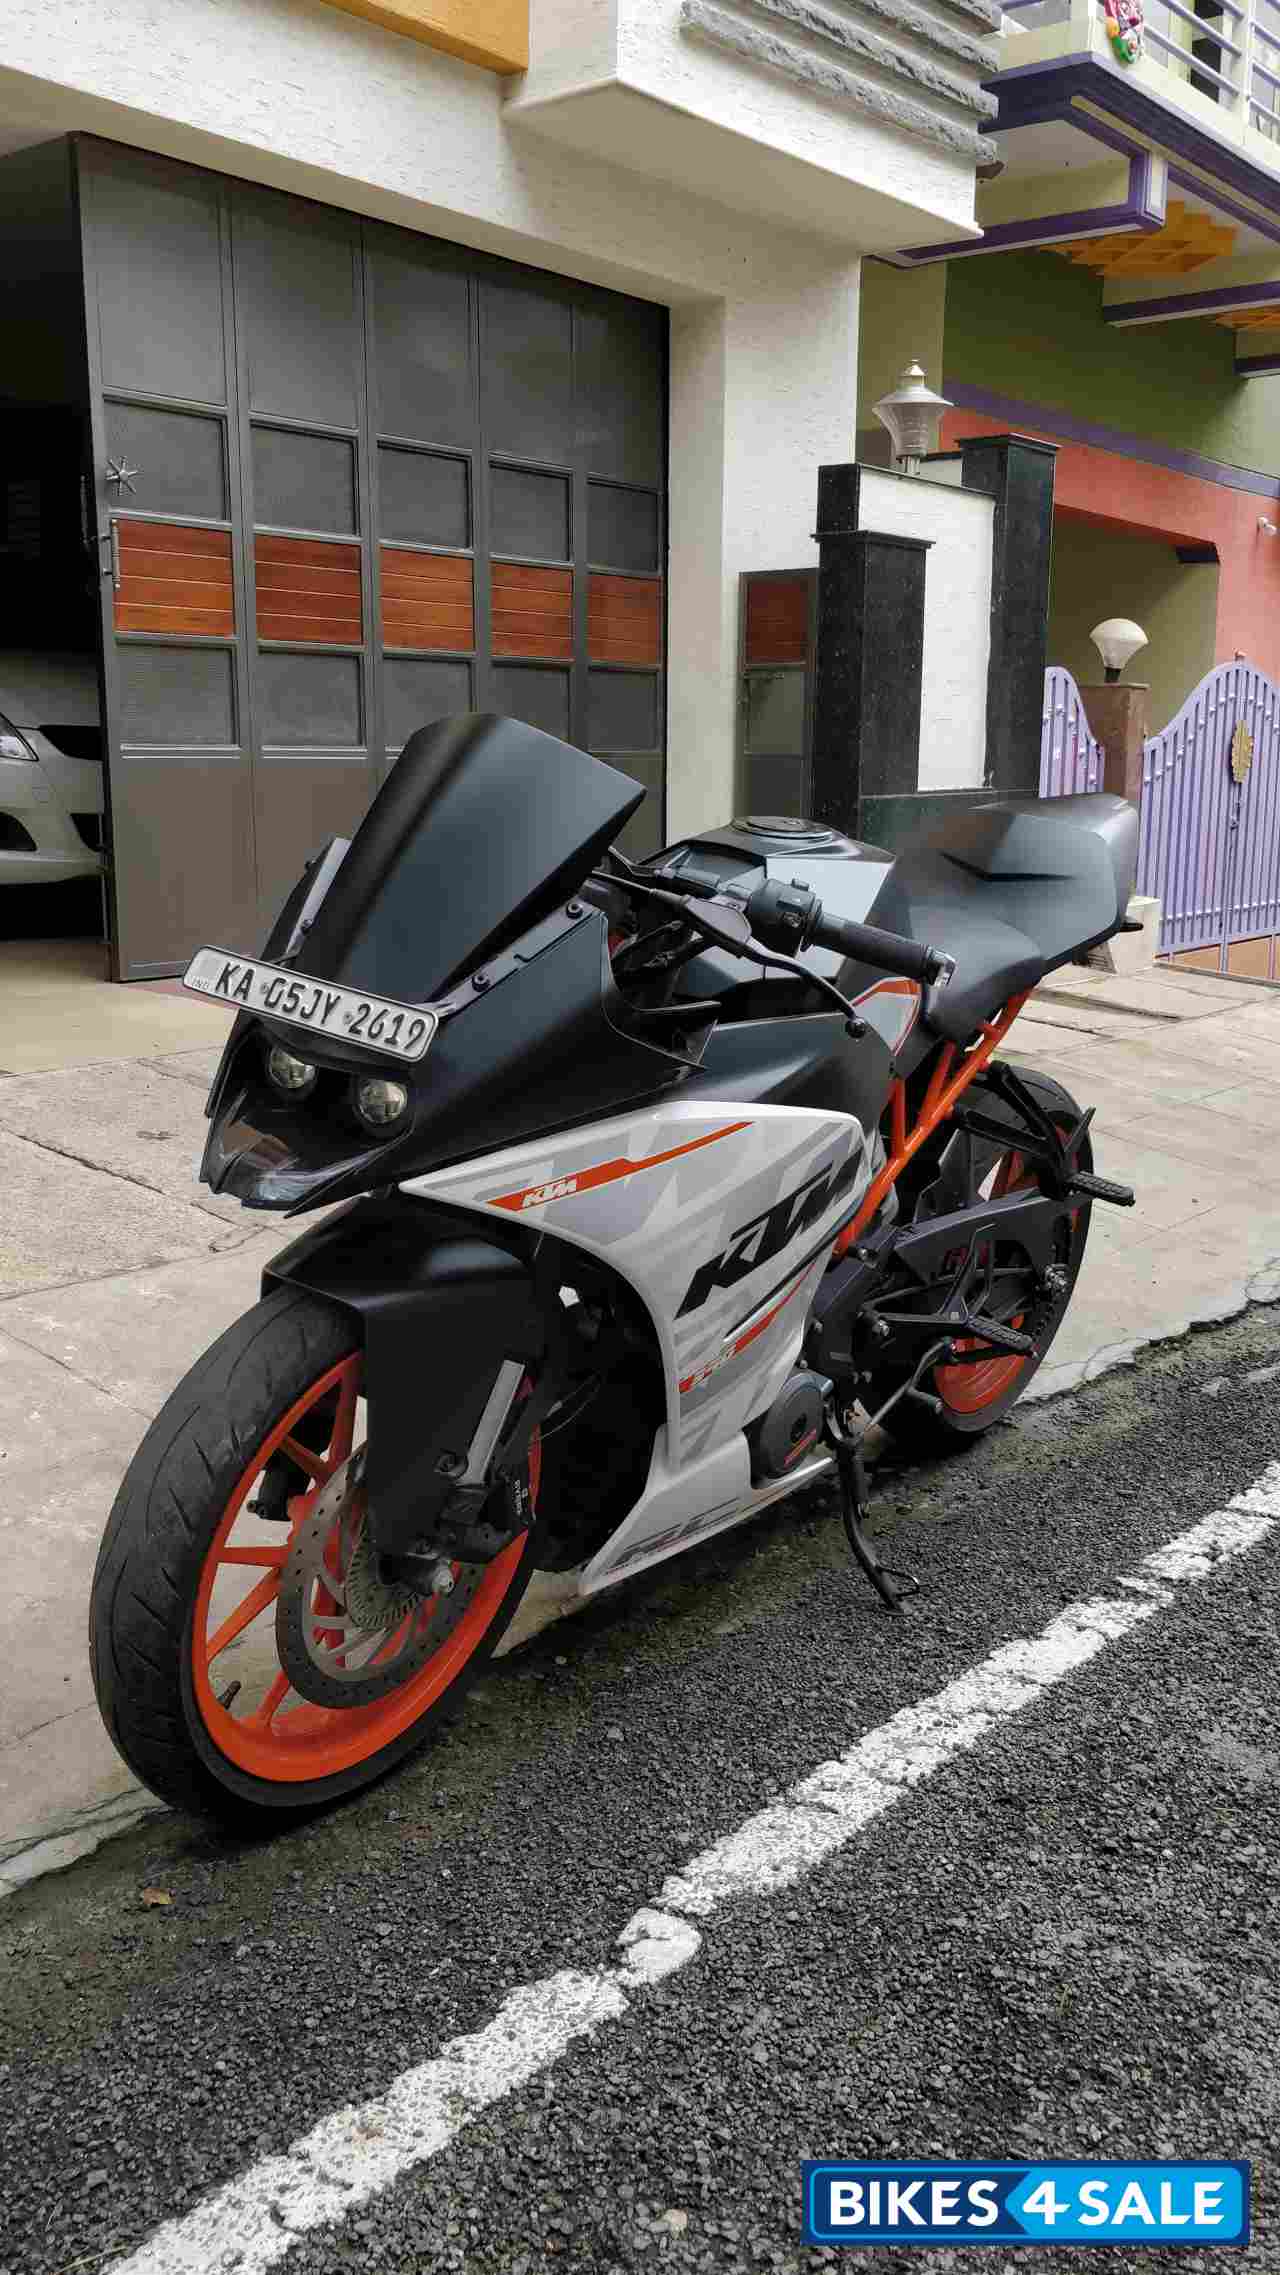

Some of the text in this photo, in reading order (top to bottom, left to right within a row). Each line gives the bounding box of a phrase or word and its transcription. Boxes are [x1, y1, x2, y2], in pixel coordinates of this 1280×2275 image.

[215, 961, 426, 1050] KA 05JY 2619
[521, 1179, 577, 1208] KTM
[673, 1145, 862, 1320] KTM
